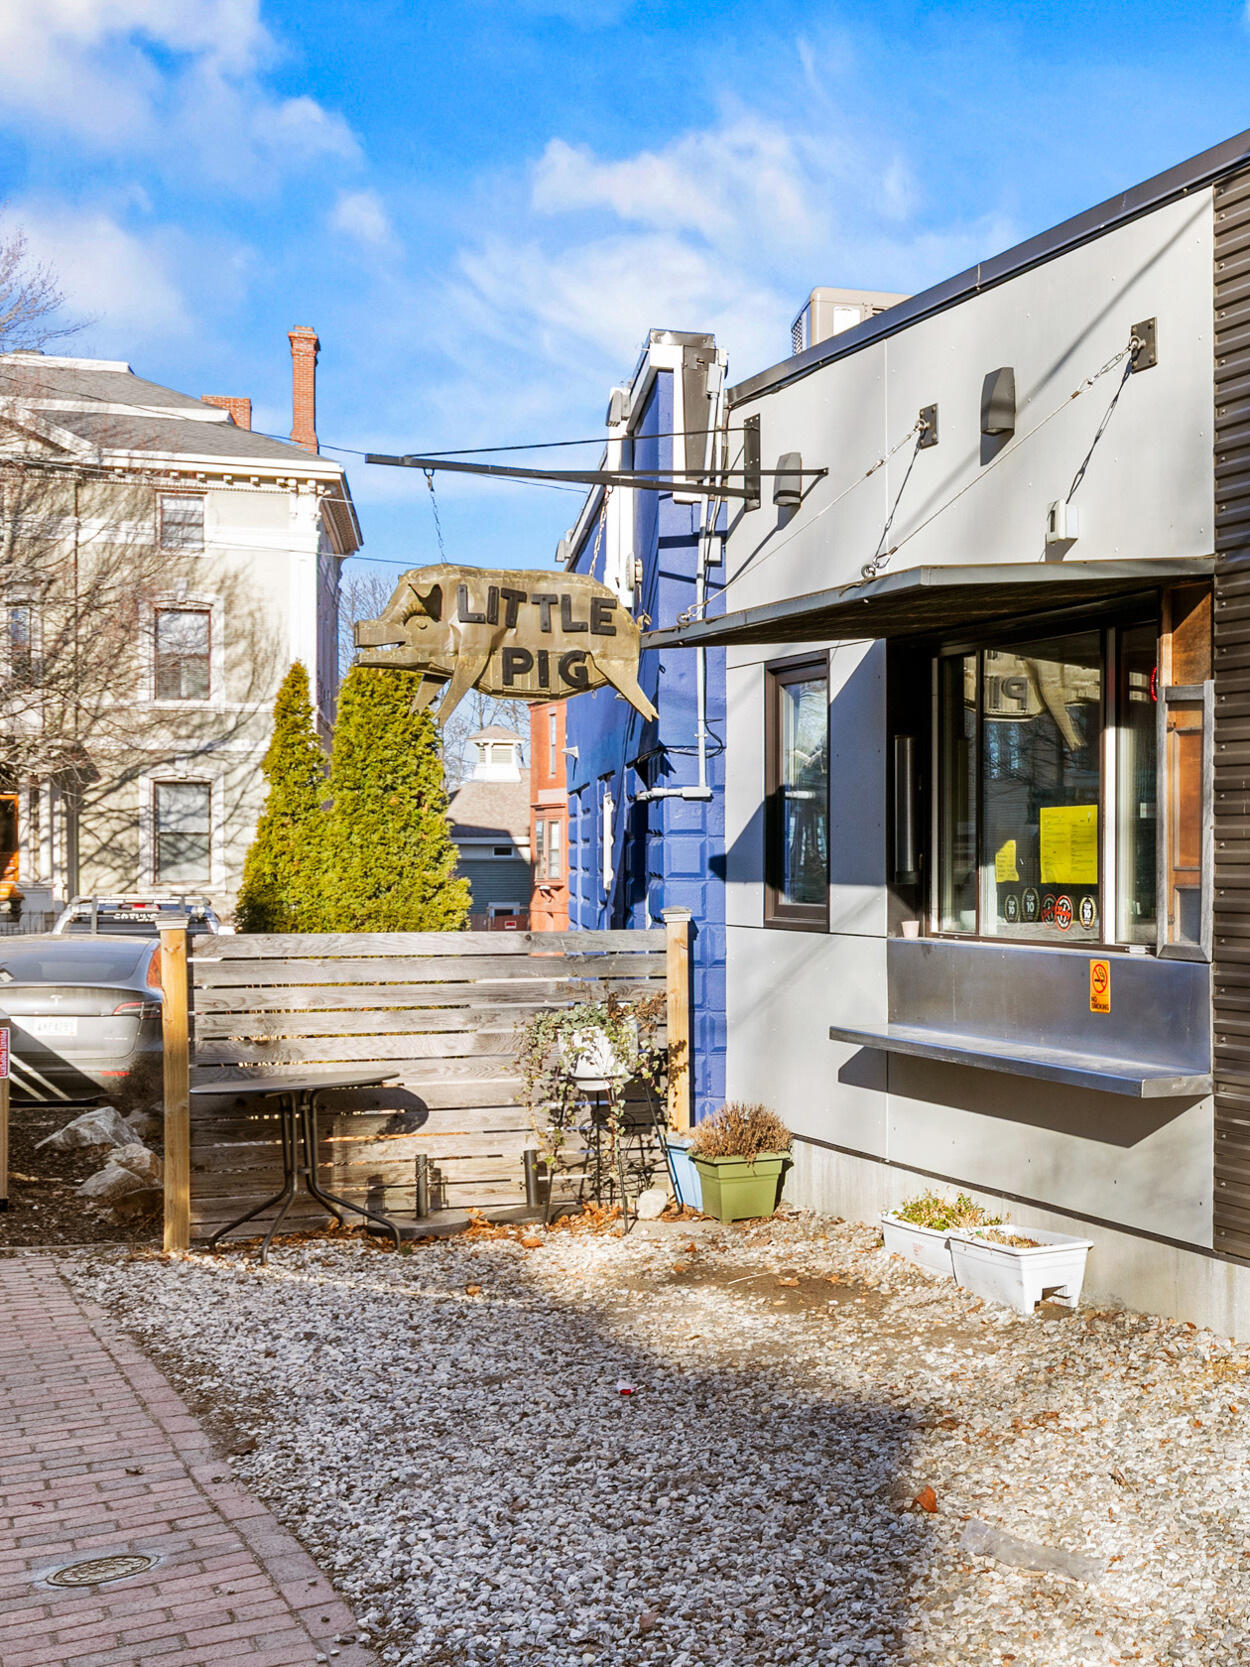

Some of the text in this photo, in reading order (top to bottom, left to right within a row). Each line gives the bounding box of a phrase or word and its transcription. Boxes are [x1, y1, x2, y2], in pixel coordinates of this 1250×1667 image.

[457, 583, 617, 636] LITTLE
[502, 647, 588, 688] PIG
[1026, 902, 1035, 912] 10
